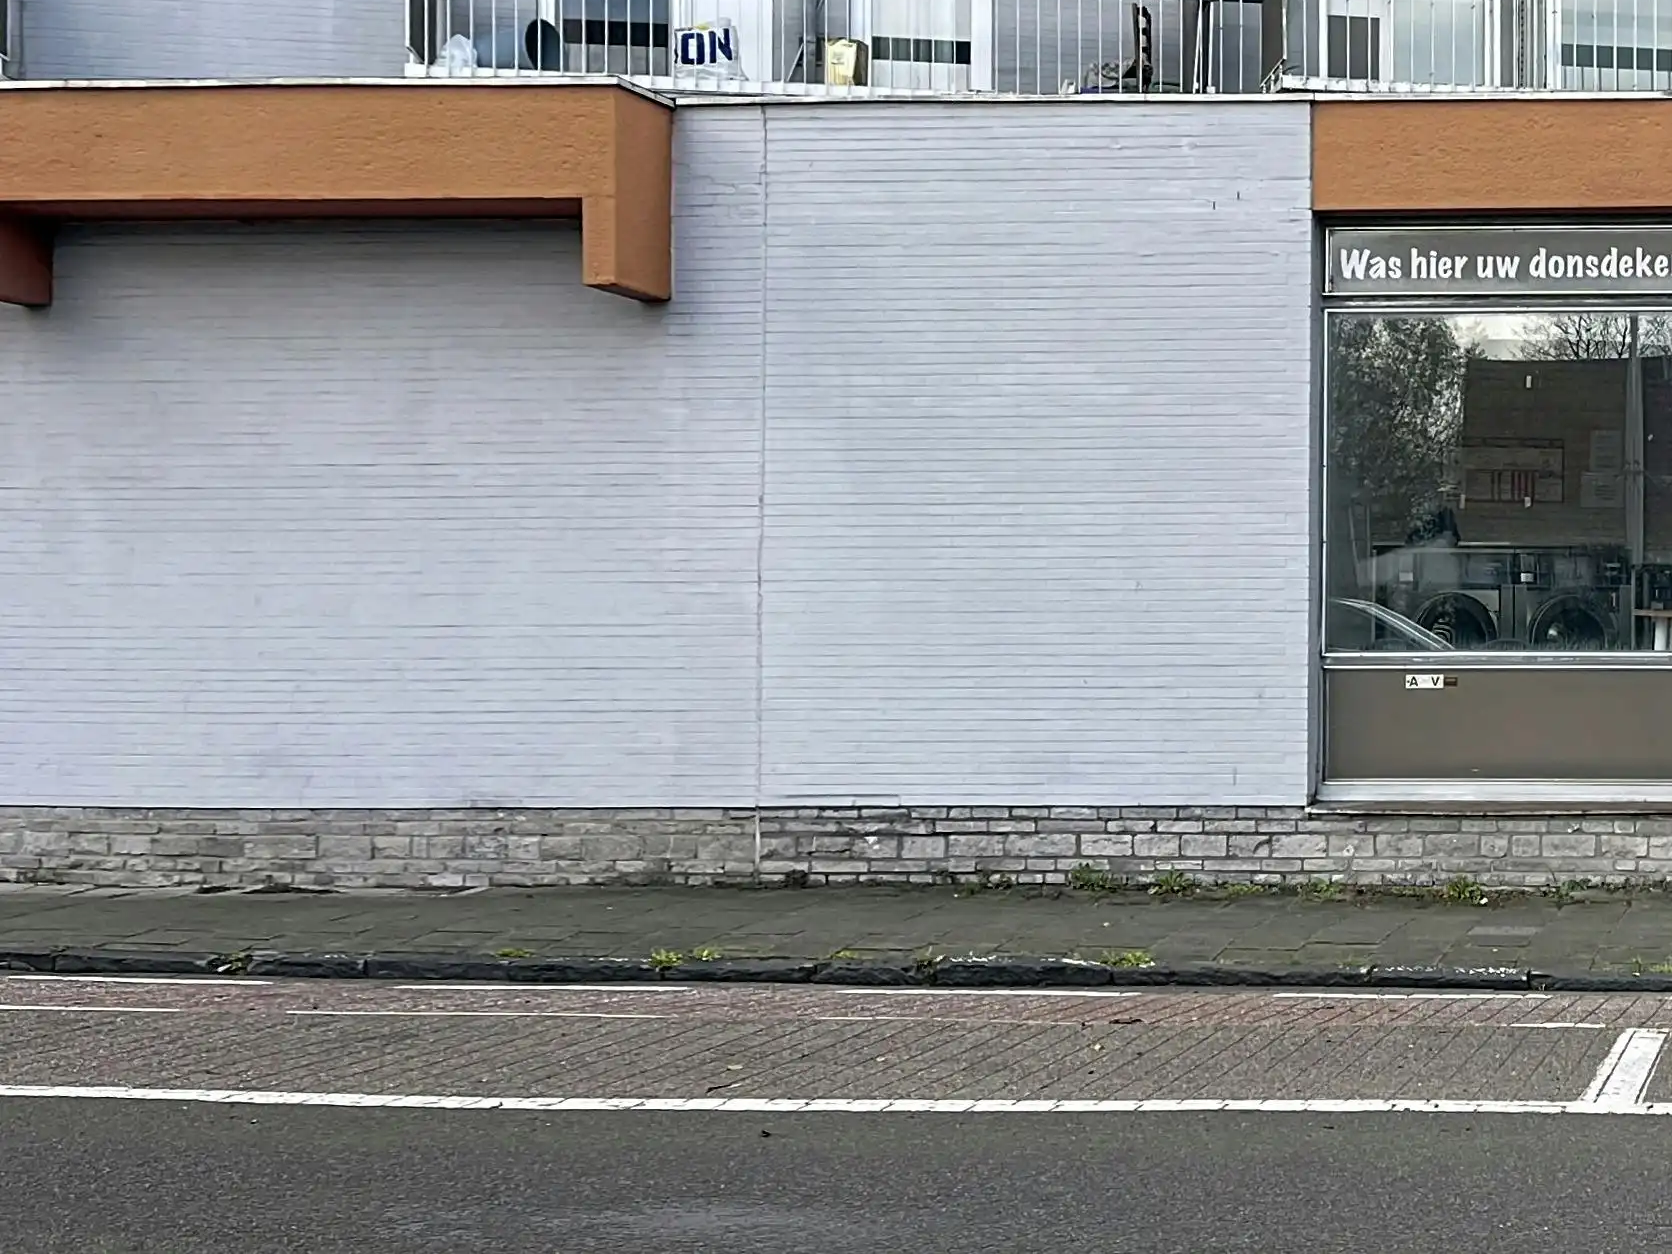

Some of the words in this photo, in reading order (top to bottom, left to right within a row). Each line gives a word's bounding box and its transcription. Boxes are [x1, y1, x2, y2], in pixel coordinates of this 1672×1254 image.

[674, 28, 733, 65] ON
[1340, 248, 1401, 280] Was
[1410, 247, 1466, 279] hier
[1477, 256, 1520, 279] uw
